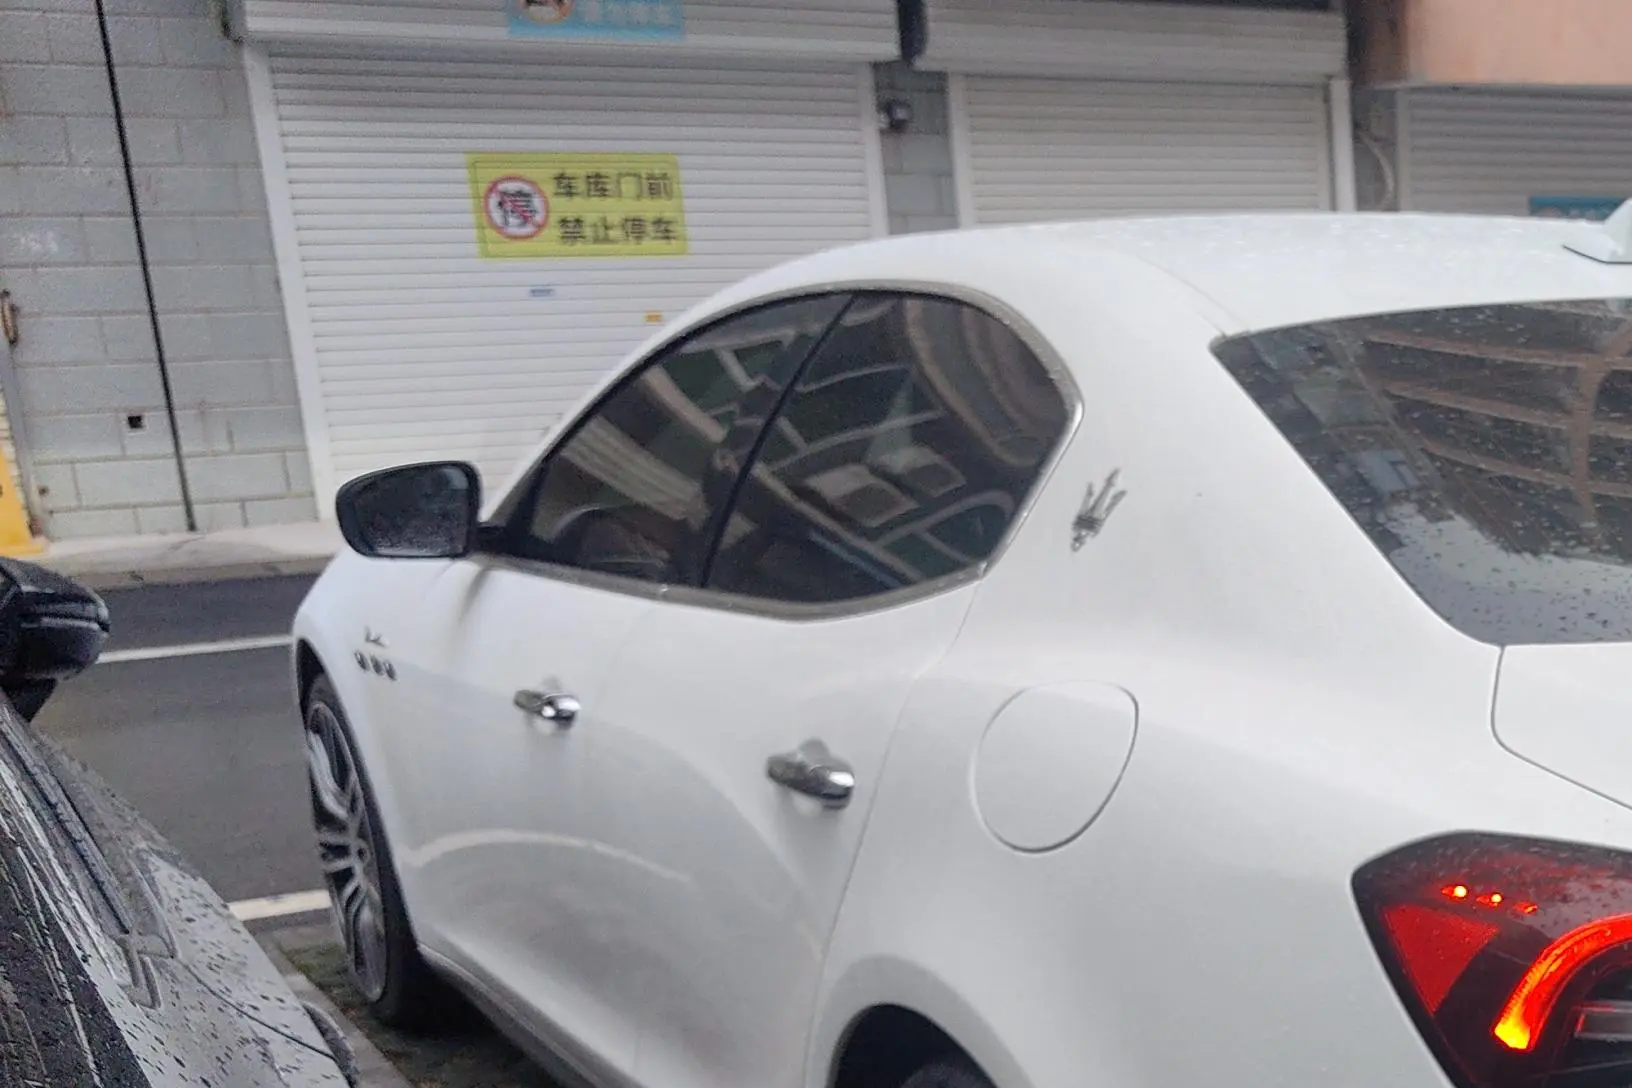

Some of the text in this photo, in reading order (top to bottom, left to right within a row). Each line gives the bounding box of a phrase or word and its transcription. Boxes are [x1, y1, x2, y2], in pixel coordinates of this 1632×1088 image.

[553, 171, 674, 202] 车库门前
[558, 216, 679, 246] 禁止停车
